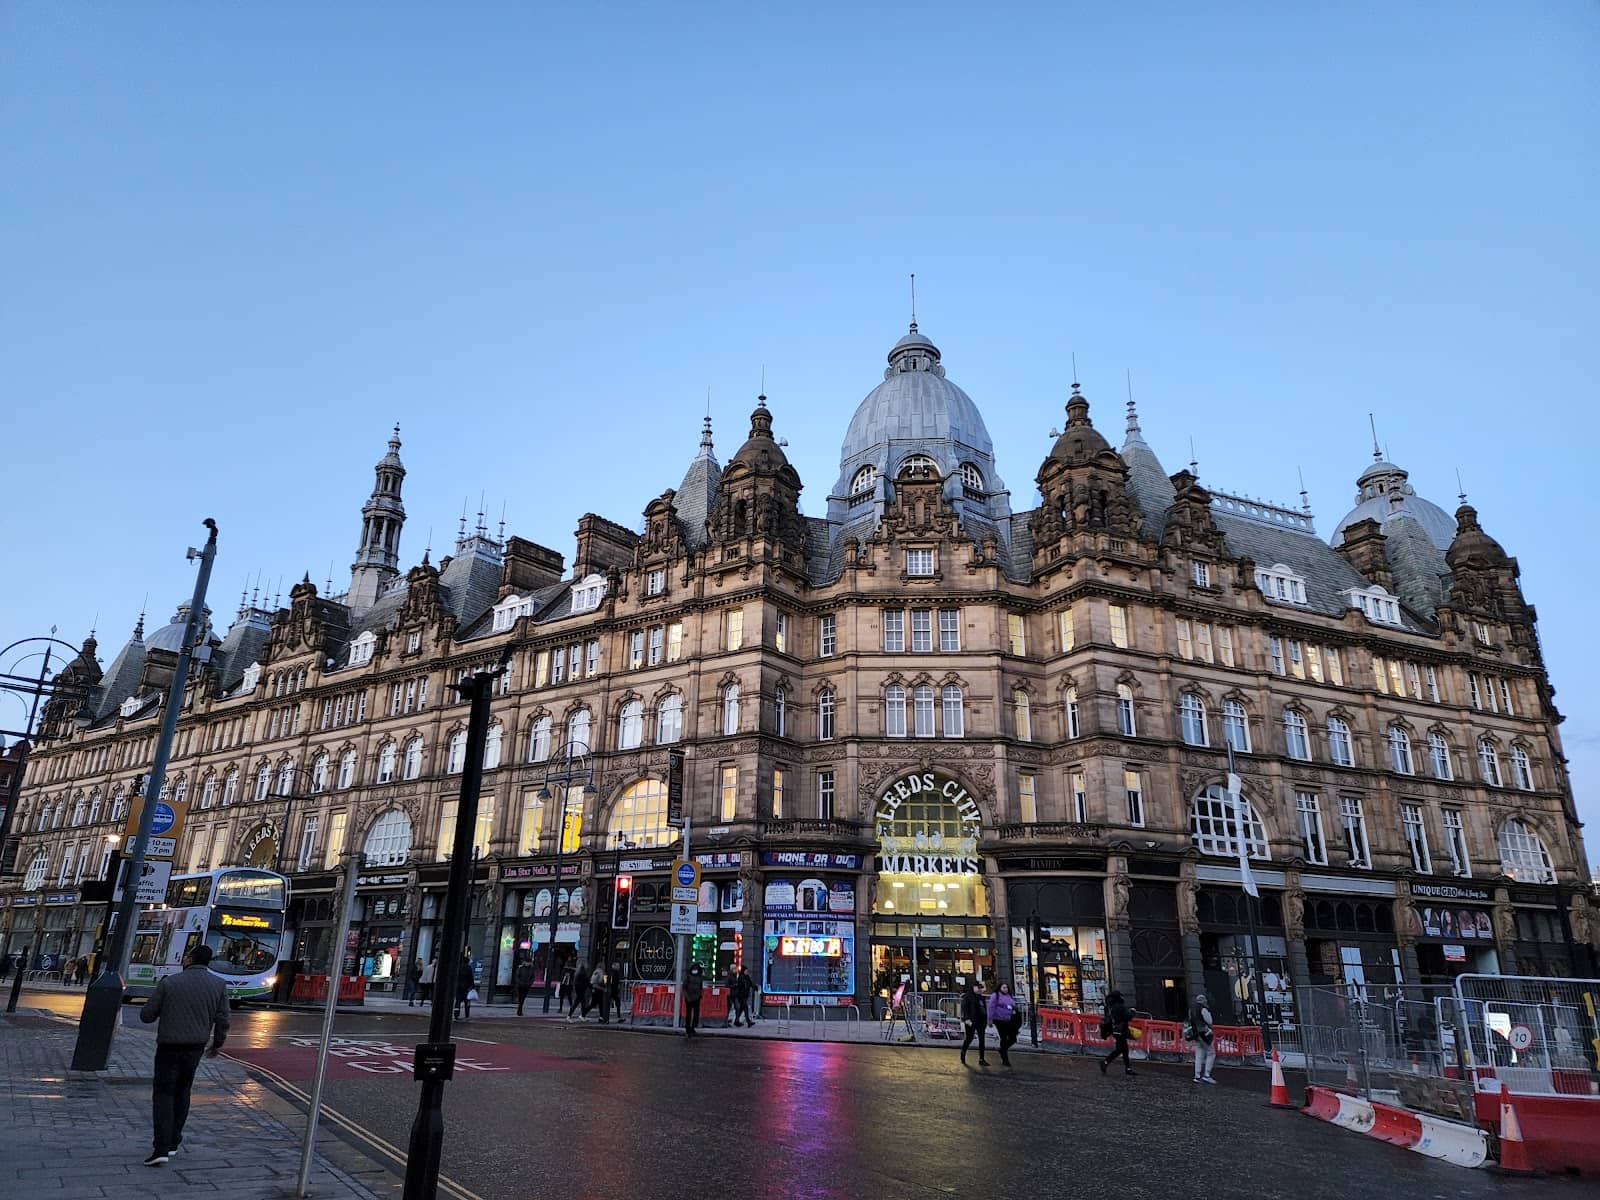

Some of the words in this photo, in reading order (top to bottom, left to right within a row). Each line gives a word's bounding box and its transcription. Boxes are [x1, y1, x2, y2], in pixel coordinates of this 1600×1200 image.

[876, 773, 935, 820] LEEDS
[942, 780, 981, 822] CITY
[772, 852, 806, 863] PHONE
[808, 852, 828, 862] FOR
[831, 854, 848, 864] YOU
[881, 855, 979, 874] MARKETS
[560, 865, 578, 874] eauty
[1412, 884, 1440, 896] UNIQUE
[638, 940, 674, 960] Rude
[1515, 1032, 1528, 1044] 10
[345, 1058, 510, 1074] GAE
